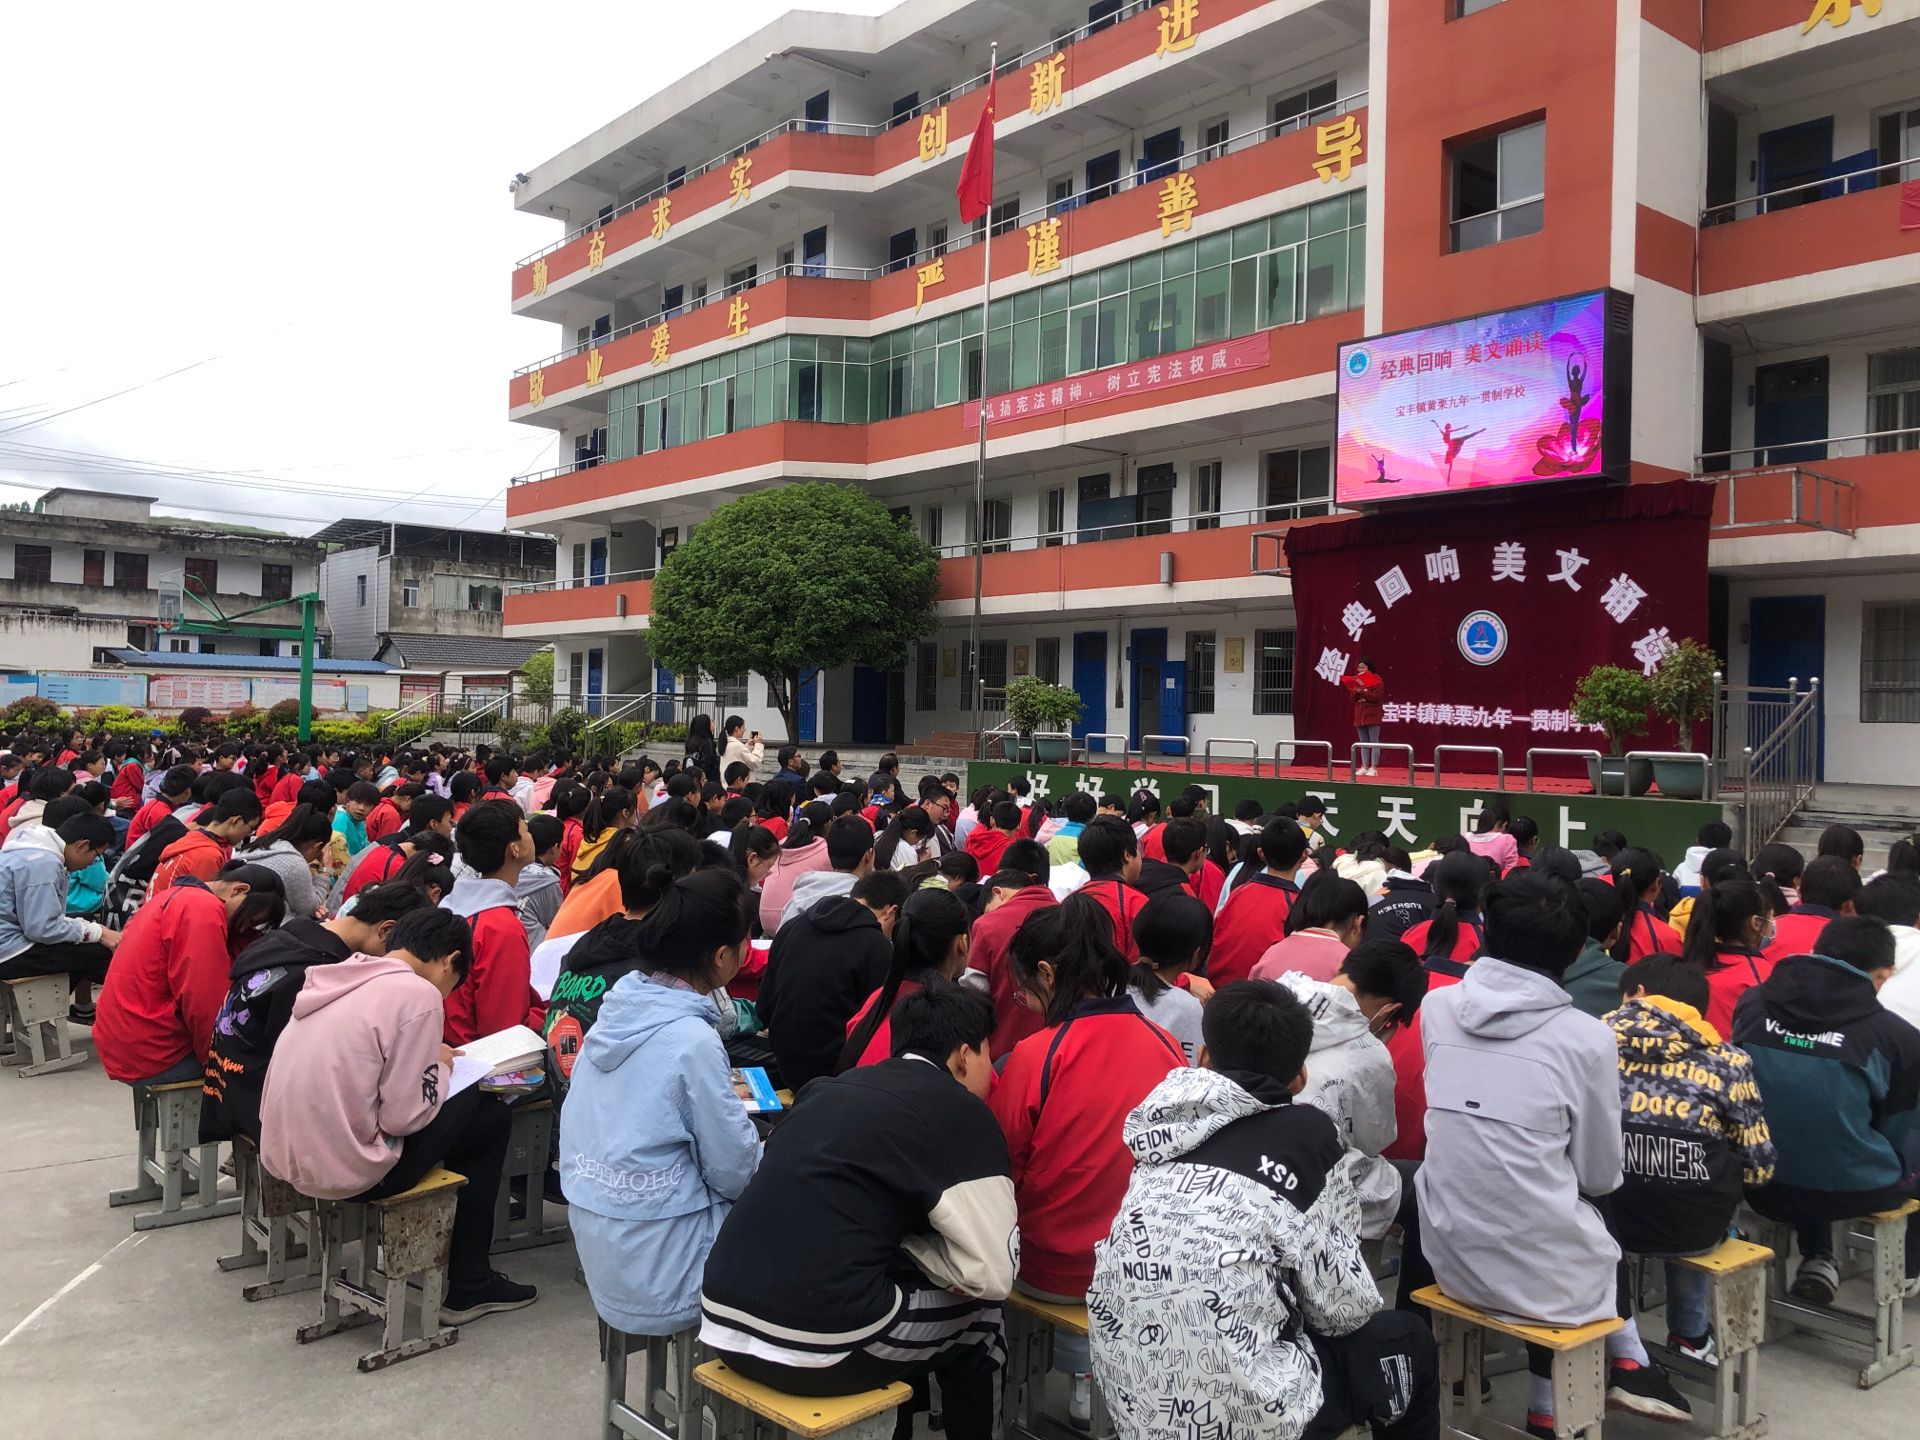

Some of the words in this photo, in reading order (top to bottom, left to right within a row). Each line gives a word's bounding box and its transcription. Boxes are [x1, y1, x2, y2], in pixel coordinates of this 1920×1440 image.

[1380, 349, 1452, 380] 经典回响
[1257, 1155, 1298, 1190] XSD
